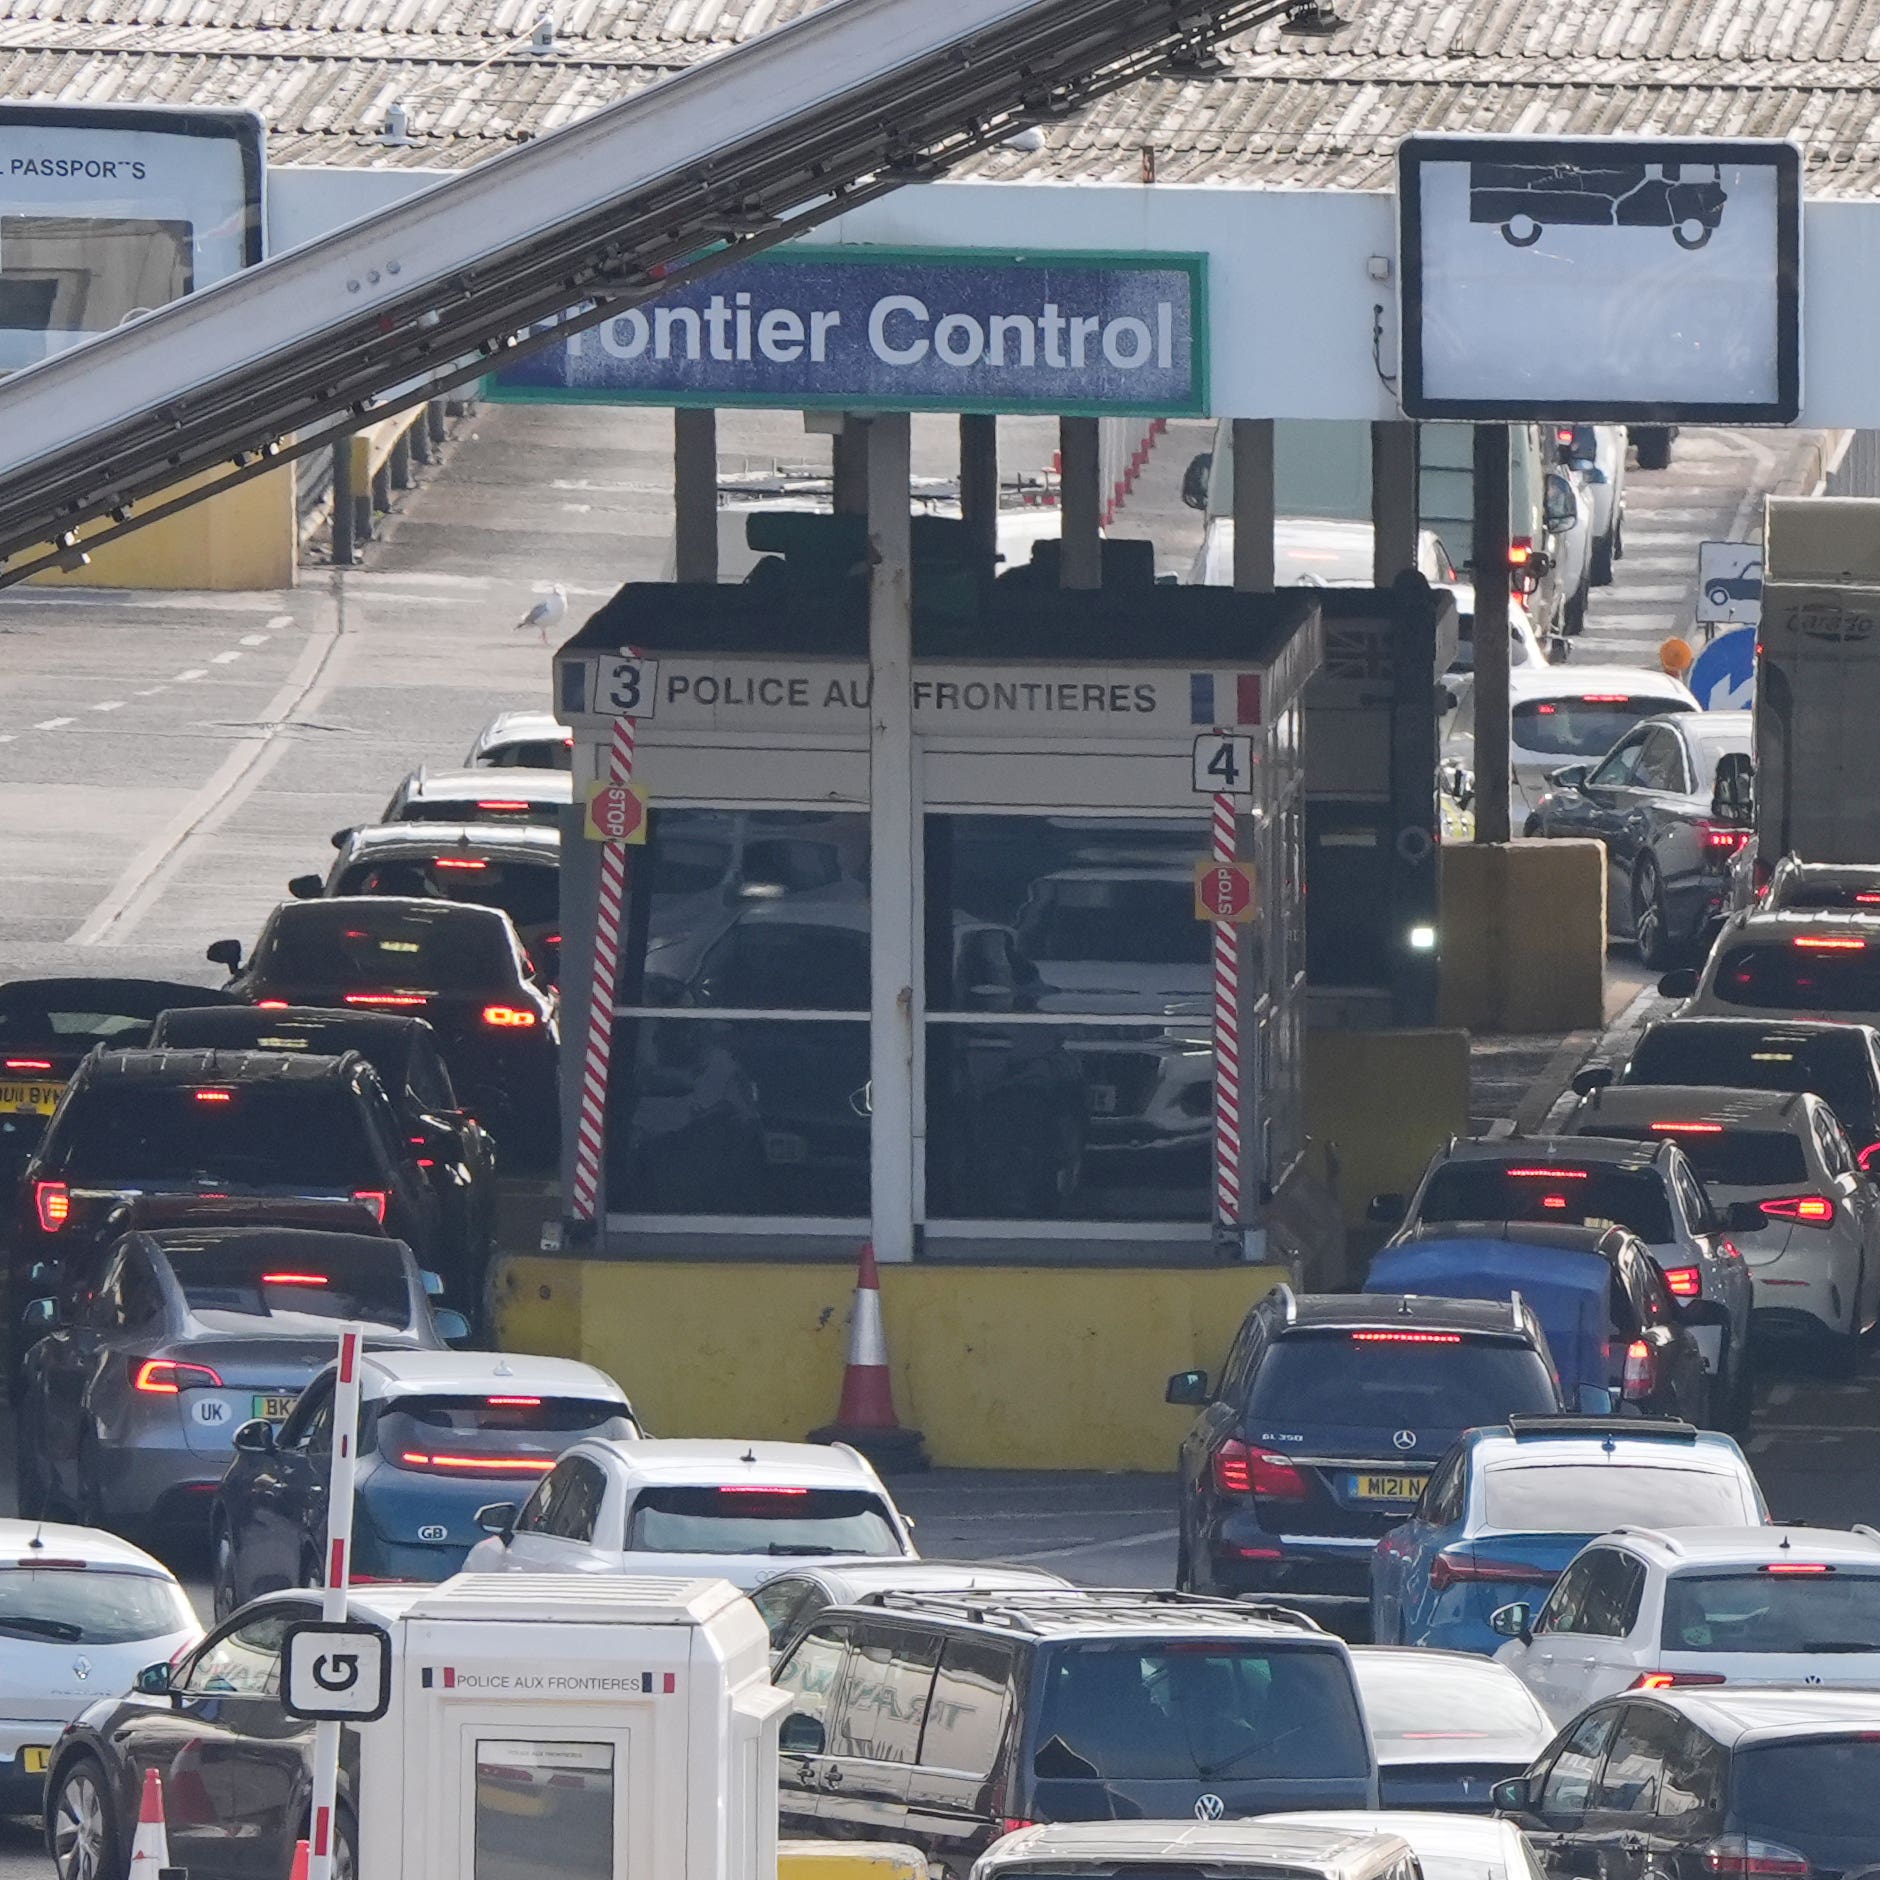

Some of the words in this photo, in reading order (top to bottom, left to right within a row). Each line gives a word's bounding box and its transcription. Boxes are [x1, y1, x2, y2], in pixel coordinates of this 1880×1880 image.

[11, 158, 146, 180] PASSPORS
[545, 293, 841, 362] rontier
[869, 296, 1173, 370] Control
[610, 664, 640, 709] 3
[667, 676, 812, 708] POLICE
[824, 678, 871, 709] AU
[914, 681, 1157, 713] FRONTIERES
[1208, 743, 1240, 785] 4
[606, 789, 625, 836] STOP
[1217, 868, 1231, 915] STOP
[201, 1401, 223, 1423] UK
[421, 1526, 443, 1540] GB
[312, 1654, 360, 1692] G
[457, 1675, 510, 1690] POLICE
[514, 1676, 544, 1691] AUX
[548, 1677, 641, 1692] FRONTIERES
